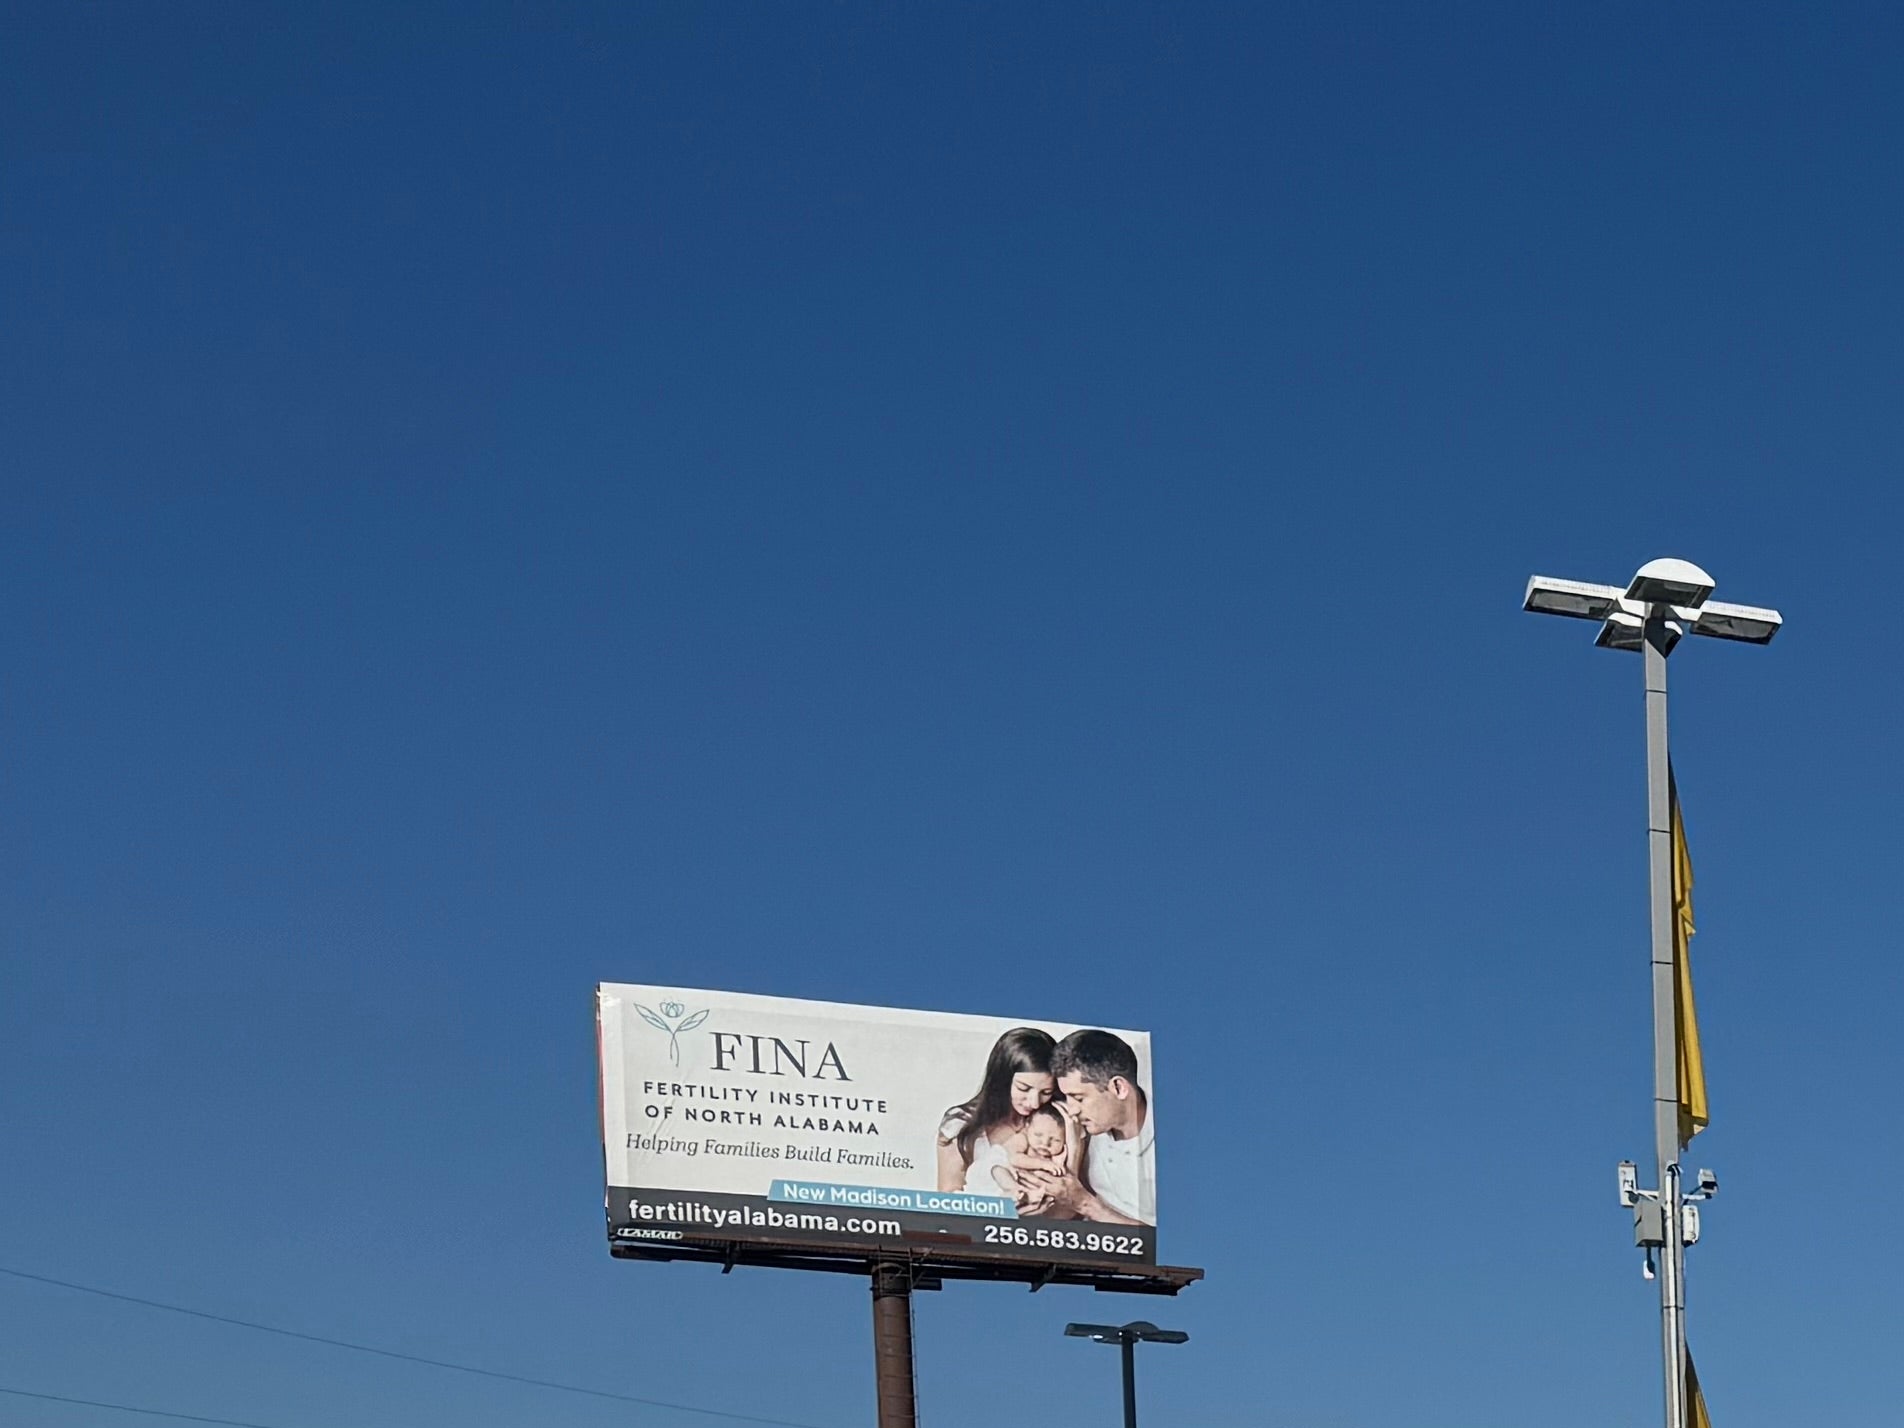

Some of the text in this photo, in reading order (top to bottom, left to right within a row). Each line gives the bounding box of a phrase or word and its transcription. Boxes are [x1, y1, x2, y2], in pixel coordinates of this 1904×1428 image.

[709, 1031, 853, 1082] FINA
[644, 1081, 887, 1113] FERTILITY INSTITUTE
[645, 1104, 879, 1135] OF NORTH ALABAMA
[626, 1133, 914, 1170] Helping Families Build Families.
[783, 1183, 1004, 1216] New Madison Location!
[629, 1199, 901, 1236] fertilityalabama.com
[984, 1224, 1144, 1255] 256.583.9622
